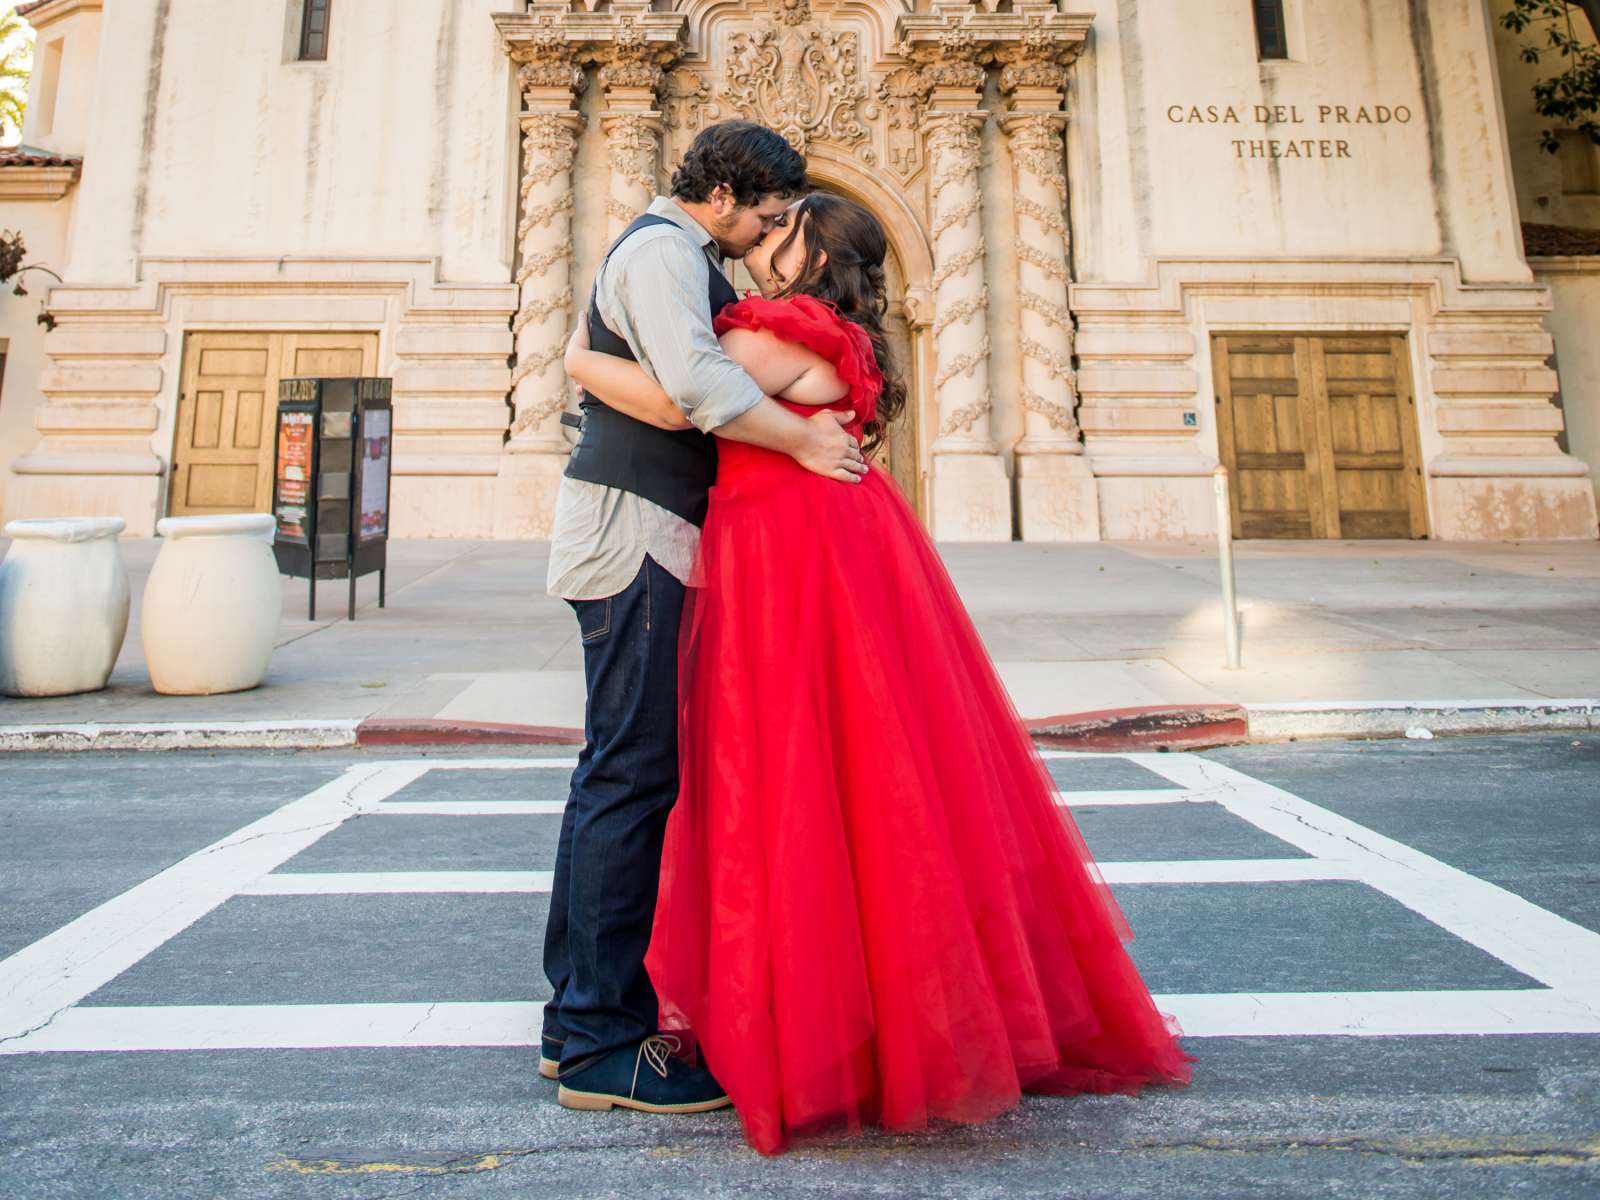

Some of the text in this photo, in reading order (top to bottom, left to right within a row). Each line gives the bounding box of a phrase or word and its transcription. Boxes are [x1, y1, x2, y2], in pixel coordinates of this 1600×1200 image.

[1167, 105, 1412, 124] CASA DEL PRADO
[1232, 140, 1352, 158] THEATER
